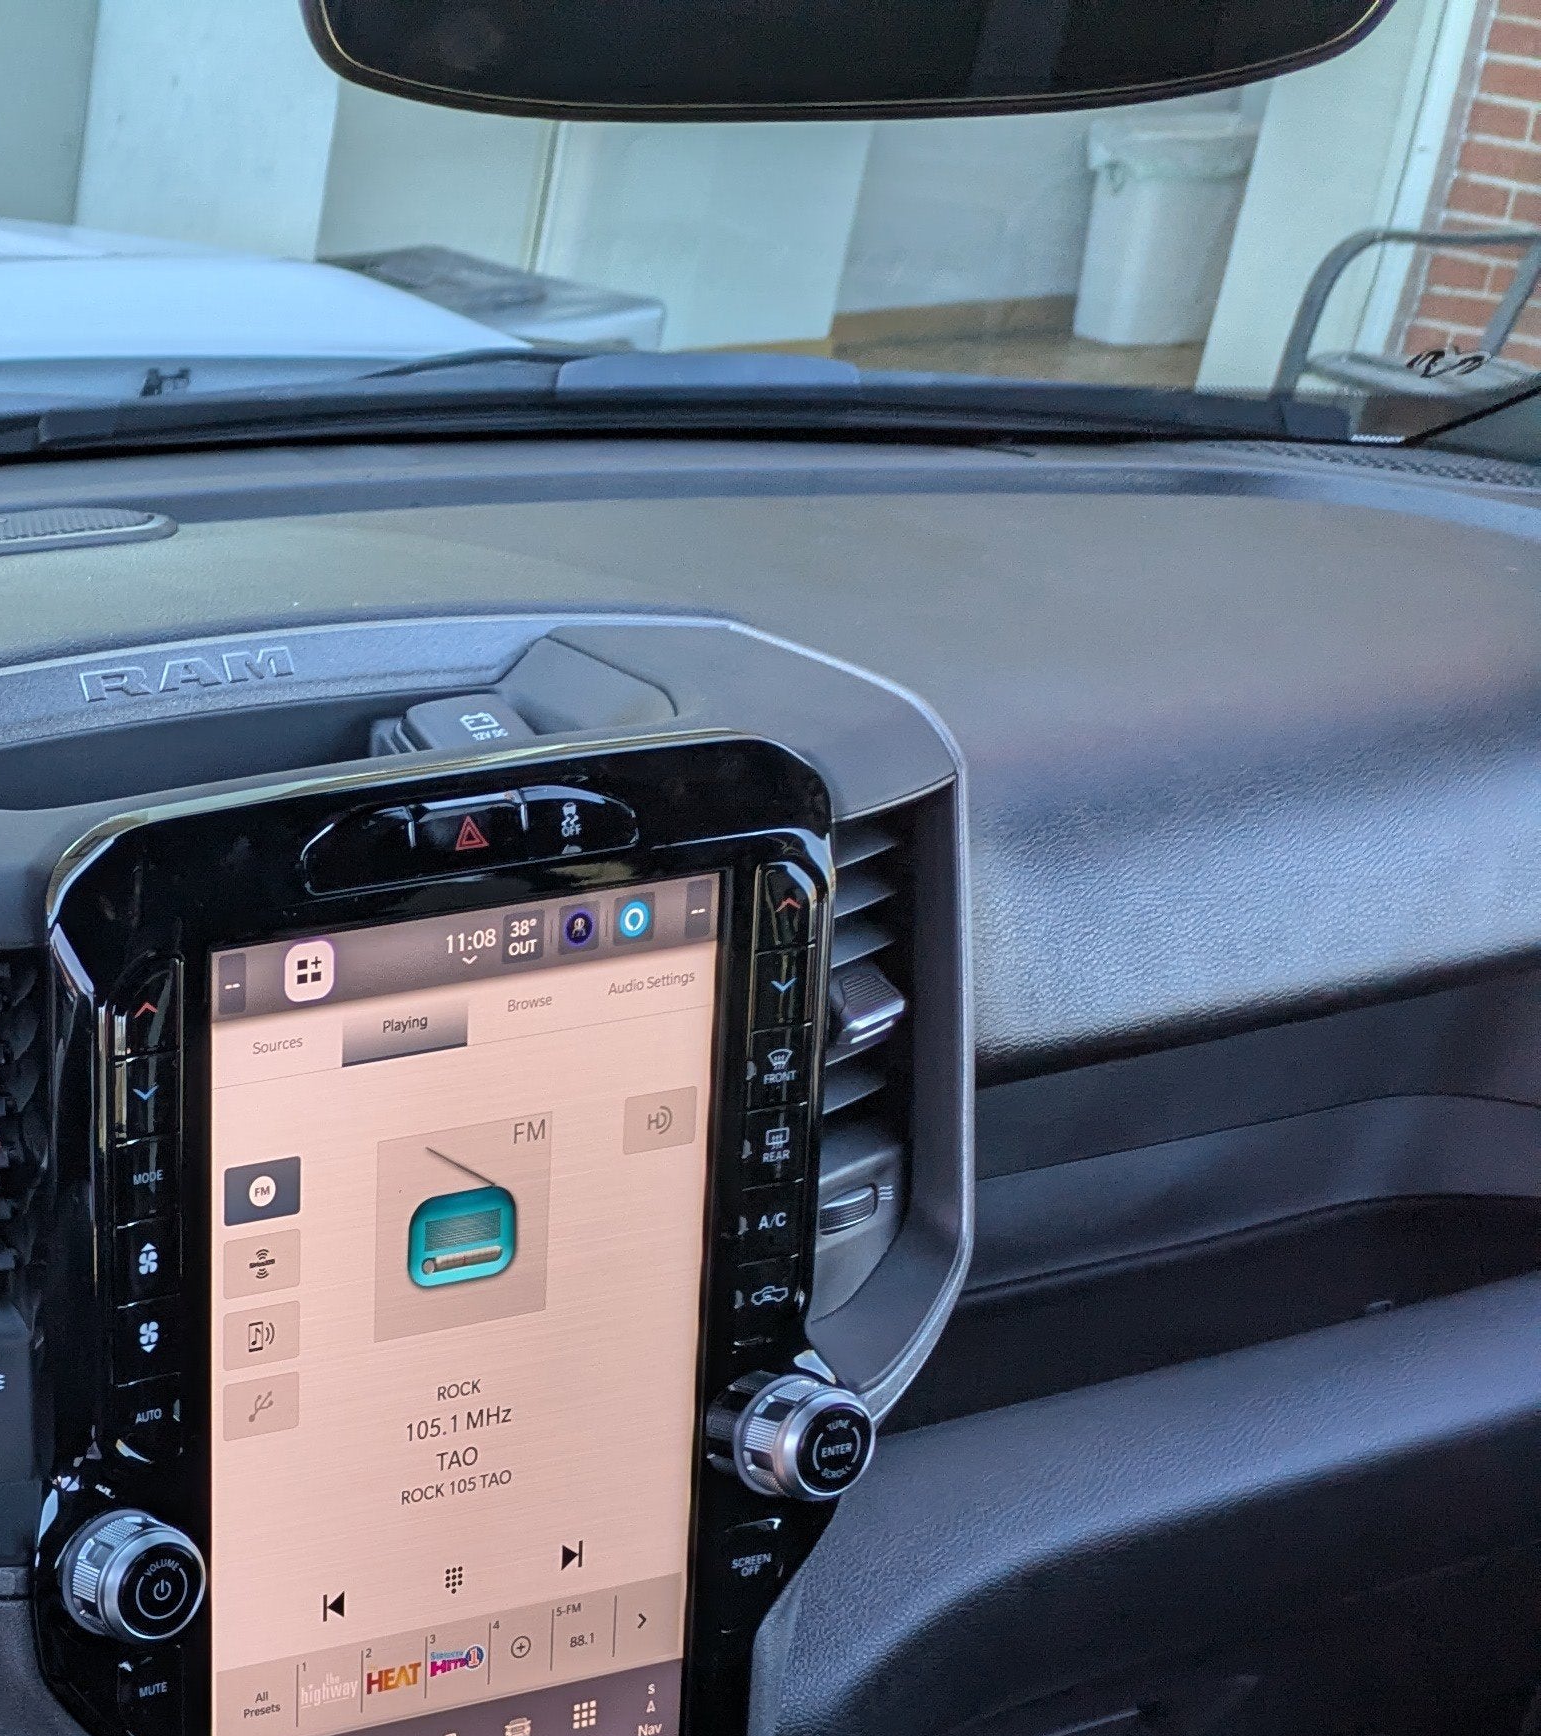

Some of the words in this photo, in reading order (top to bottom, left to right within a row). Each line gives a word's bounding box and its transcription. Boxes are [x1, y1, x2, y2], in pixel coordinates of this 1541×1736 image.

[78, 646, 295, 702] RAM
[561, 823, 583, 837] OFF
[509, 917, 538, 938] 38°
[445, 927, 497, 954] 11:08
[508, 938, 538, 957] OUT
[608, 977, 643, 996] Audio
[645, 969, 696, 993] Settings
[507, 993, 553, 1013] Browse
[382, 1013, 428, 1035] Playing
[252, 1035, 303, 1055] Sources
[763, 1070, 797, 1085] FRONT
[513, 1118, 547, 1145] FM
[762, 1149, 790, 1163] REAR
[132, 1169, 164, 1185] MODE
[254, 1184, 271, 1198] FM
[758, 1211, 786, 1229] A/C
[436, 1379, 481, 1402] ROCK
[135, 1407, 162, 1423] AUTO
[406, 1414, 460, 1442] 105.1
[465, 1406, 513, 1430] MHz
[821, 1442, 852, 1457] ENTER
[436, 1446, 479, 1471] TAO
[400, 1483, 446, 1506] ROCK
[448, 1476, 478, 1496] 105
[479, 1469, 513, 1490] TAO
[143, 1558, 181, 1577] VOLUME
[731, 1552, 772, 1569] SCREEN
[740, 1564, 761, 1577] OFF
[556, 1602, 582, 1617] 5-FM
[493, 1620, 500, 1630] 4
[430, 1634, 436, 1644] 3
[570, 1633, 595, 1648] 88.1
[366, 1649, 372, 1658] 2
[302, 1662, 307, 1672] 1
[326, 1672, 340, 1686] the
[366, 1662, 422, 1695] HEAT
[139, 1682, 168, 1698] MUTE
[255, 1692, 269, 1702] All
[300, 1680, 359, 1707] highway
[244, 1703, 280, 1719] Presets
